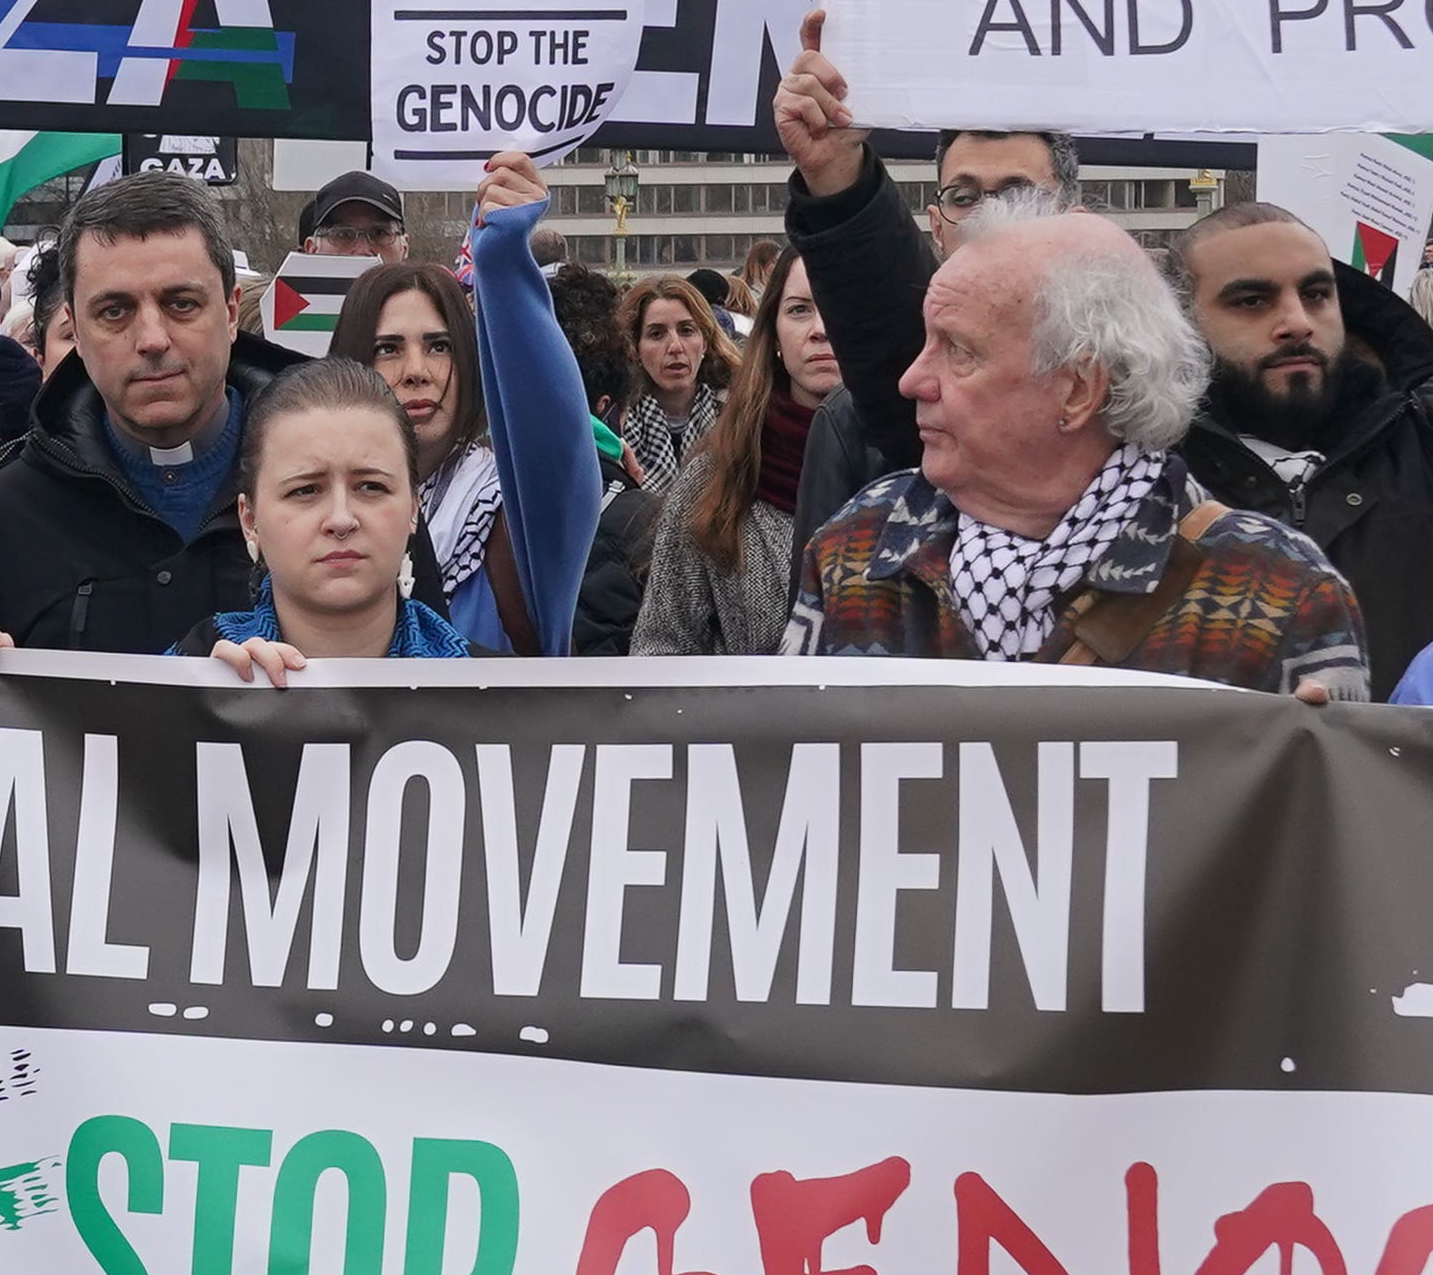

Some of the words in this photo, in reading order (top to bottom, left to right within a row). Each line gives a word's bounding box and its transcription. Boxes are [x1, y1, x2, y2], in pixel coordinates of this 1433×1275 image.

[425, 30, 518, 66] STOP
[529, 30, 591, 66] THE
[395, 81, 616, 134] GENOCIDE
[139, 157, 226, 180] GAZA
[190, 734, 1180, 1015] MOVEMENT
